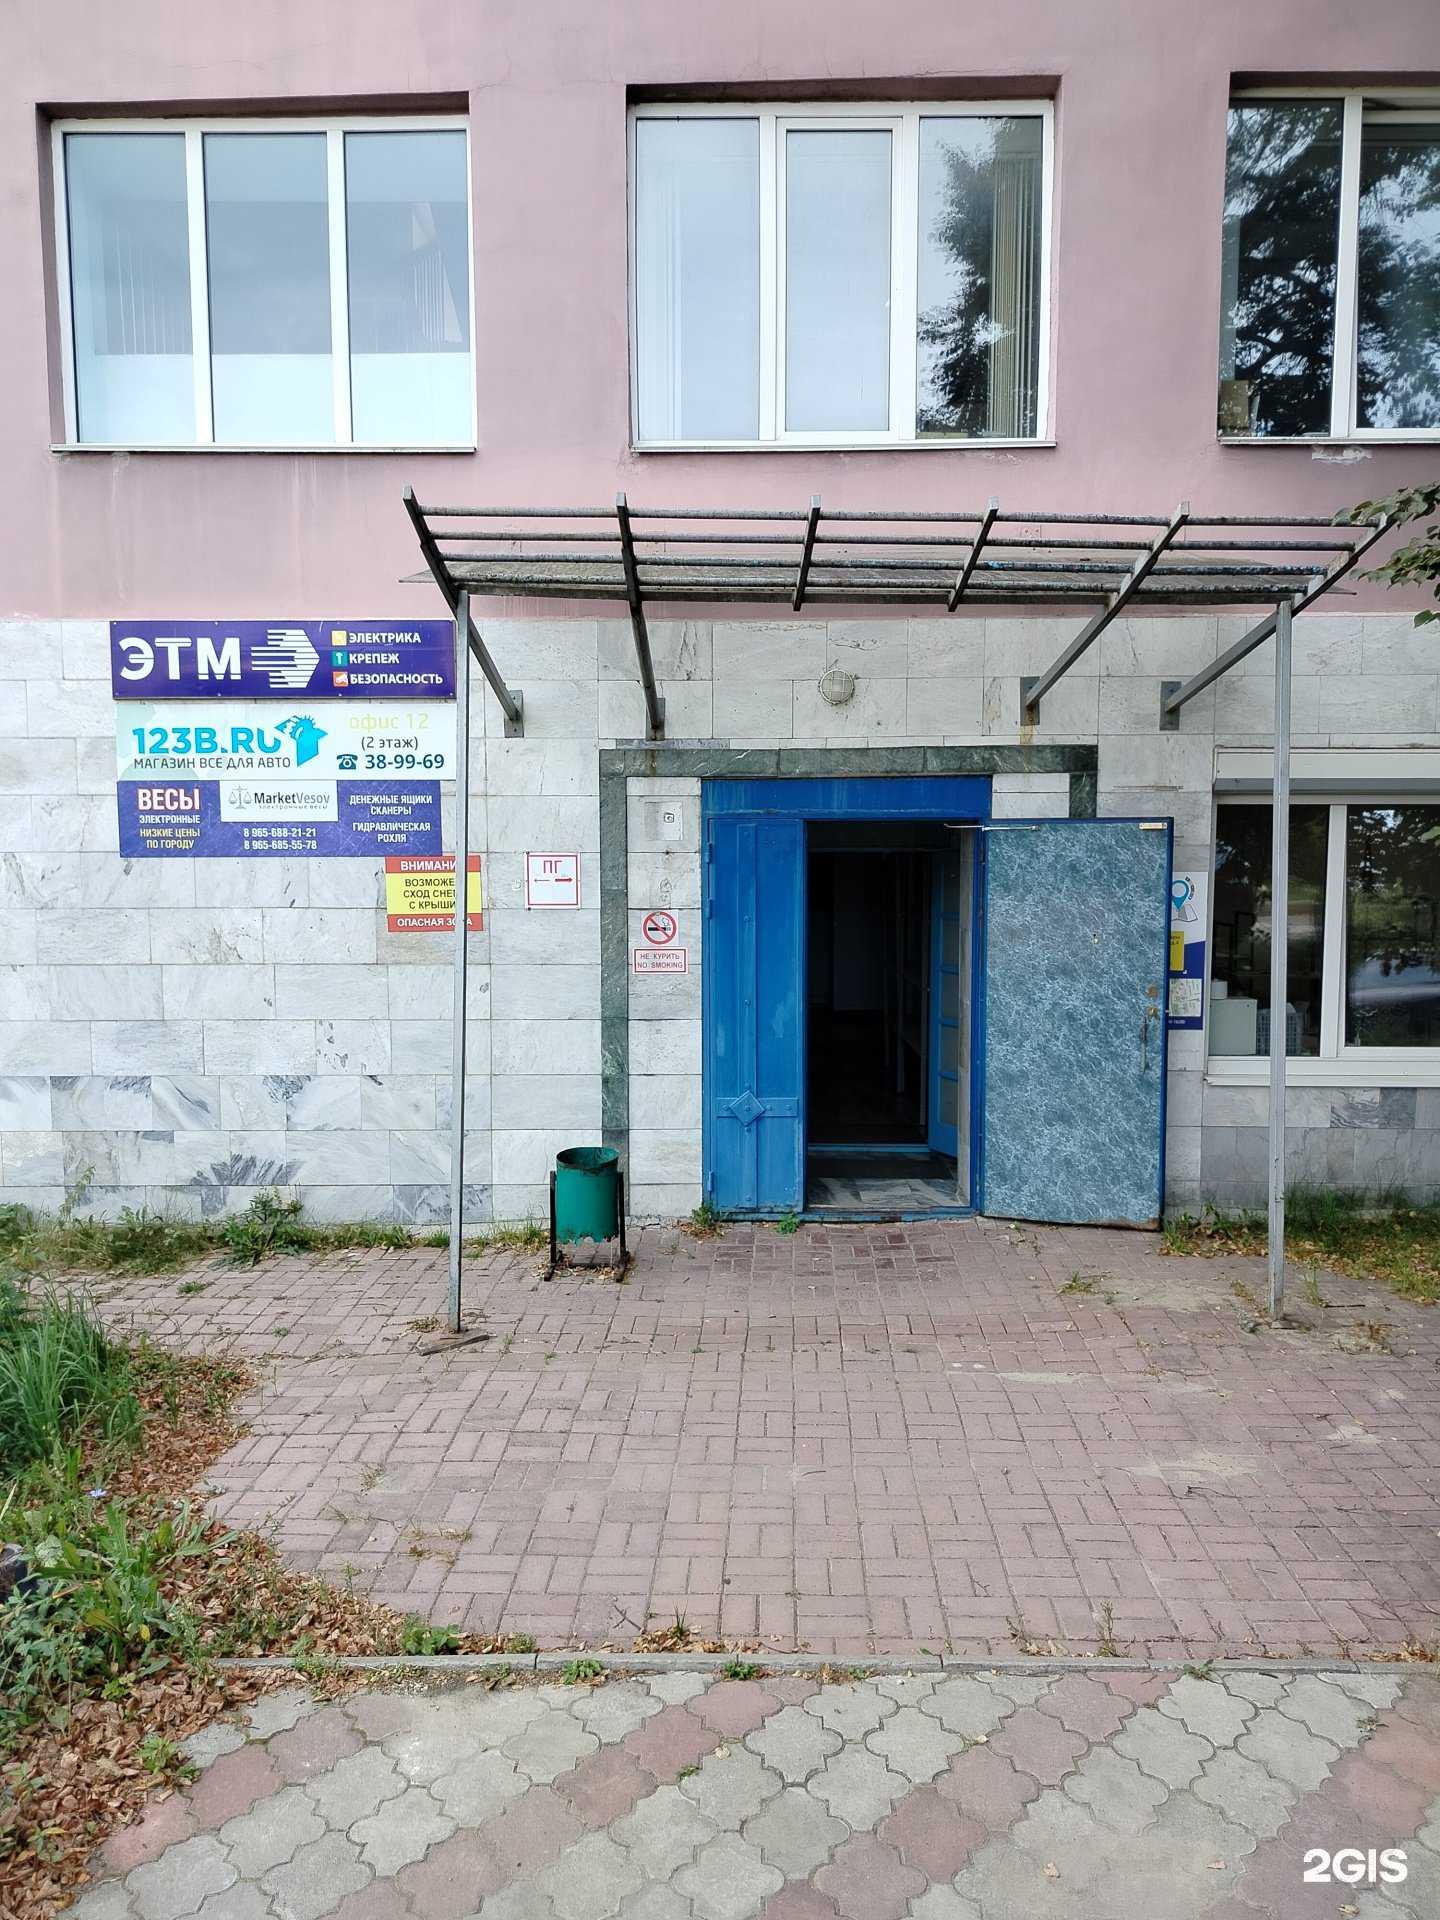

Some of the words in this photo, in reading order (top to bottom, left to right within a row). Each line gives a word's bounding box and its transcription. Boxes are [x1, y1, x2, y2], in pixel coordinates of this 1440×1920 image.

[349, 632, 421, 644] ЭЛЕКТРИКА
[119, 637, 242, 680] ЭТМ
[349, 653, 400, 664] КРЕПЕЖ
[350, 673, 443, 685] БЕЗОПАСНОСТЬ
[349, 713, 399, 732] офис
[406, 713, 429, 729] 12
[361, 736, 375, 751] (2
[379, 736, 419, 751] этаж)
[134, 757, 195, 769] МАГАЗИН
[200, 757, 223, 769] ВСЕ
[226, 757, 254, 770] ДЛЯ
[257, 756, 291, 768] АВТО
[365, 754, 445, 769] 38-99-69
[137, 788, 200, 811] ВЕСЫ
[254, 792, 330, 804] MarketVesov
[349, 795, 399, 806] ДЕНЕЖНЫЕ
[400, 795, 433, 806] ЯЩИКИ
[370, 806, 412, 815] СКАНЕРЫ
[139, 814, 201, 824] ЭЛЕКТРОННЫЕ
[243, 828, 250, 838] 8
[251, 827, 317, 838] 965-688-21-21
[352, 822, 431, 833] ГИДРАВЛИЧЕСКАЯ
[140, 828, 173, 838] НИЗКИЕ
[175, 828, 201, 839] ЦЕНЫ
[377, 833, 407, 843] РОХЛЯ
[146, 839, 159, 849] ПО
[160, 839, 195, 850] ГОРОДУ
[243, 840, 250, 850] 8
[400, 860, 457, 871] ВНИМАНИ
[543, 860, 563, 874] ПГ
[404, 878, 455, 887] ВОЗМОЖЕ
[403, 889, 430, 899] СХОД
[432, 889, 456, 898] СНЕ
[409, 901, 416, 909] С
[397, 918, 444, 927] ОПАСНАЯ
[446, 917, 473, 926] ЗА
[637, 961, 648, 969] NO
[650, 961, 684, 969] SMOKING
